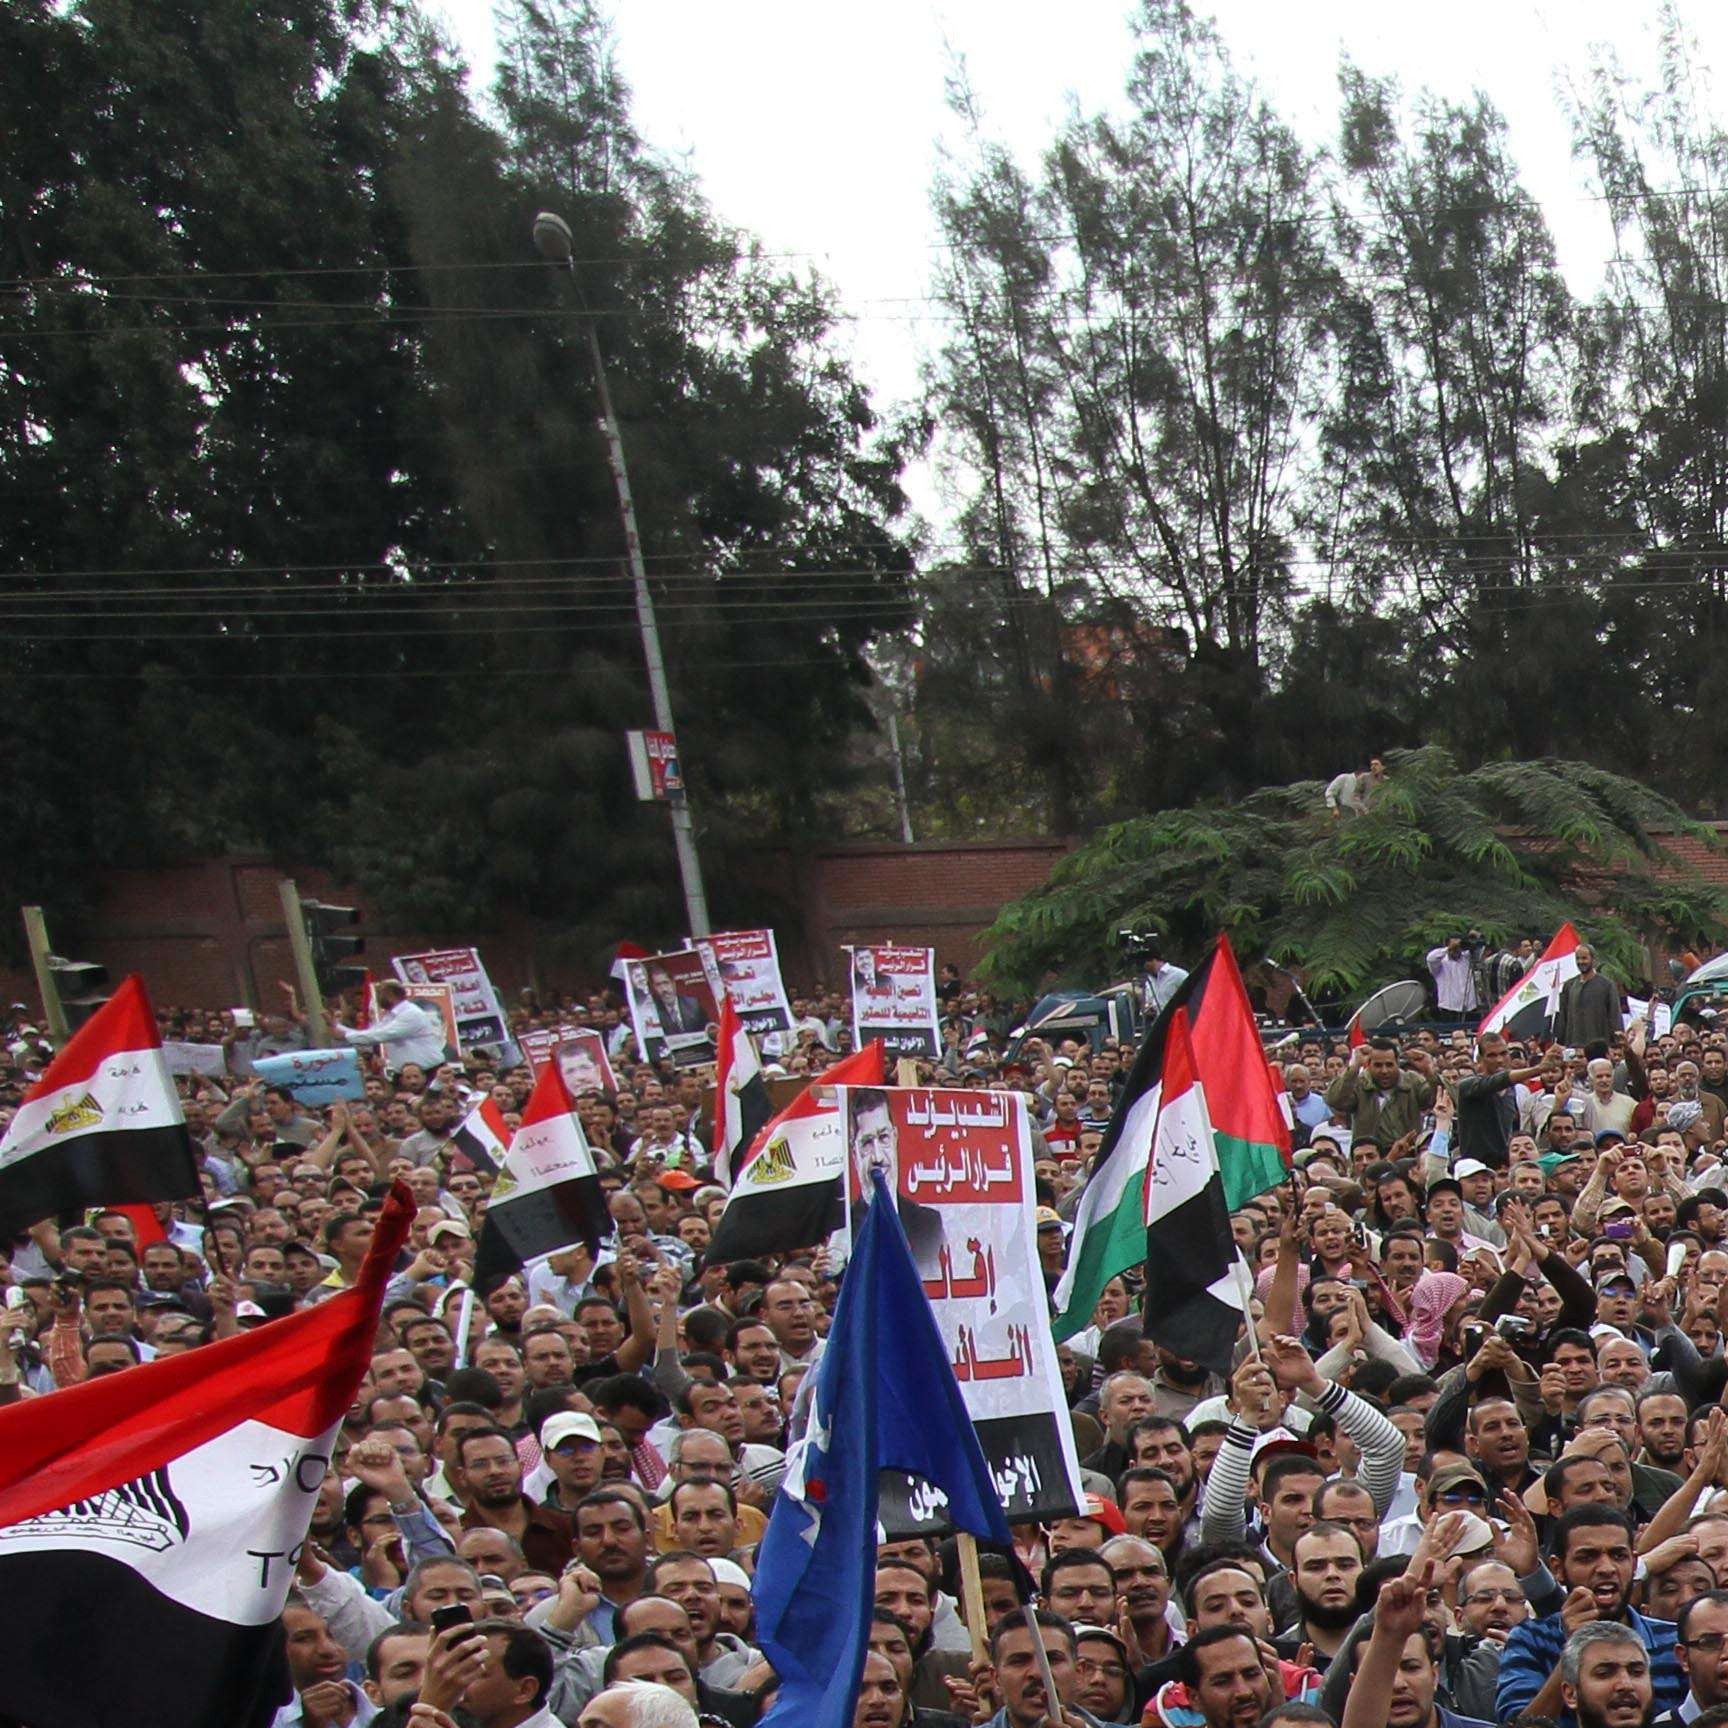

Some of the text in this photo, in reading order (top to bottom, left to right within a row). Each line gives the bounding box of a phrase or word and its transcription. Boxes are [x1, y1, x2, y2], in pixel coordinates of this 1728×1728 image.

[906, 1093, 1009, 1140] الشعب يؤيد
[907, 1144, 1013, 1194] قرار الرئيس
[922, 1236, 997, 1316] إقال
